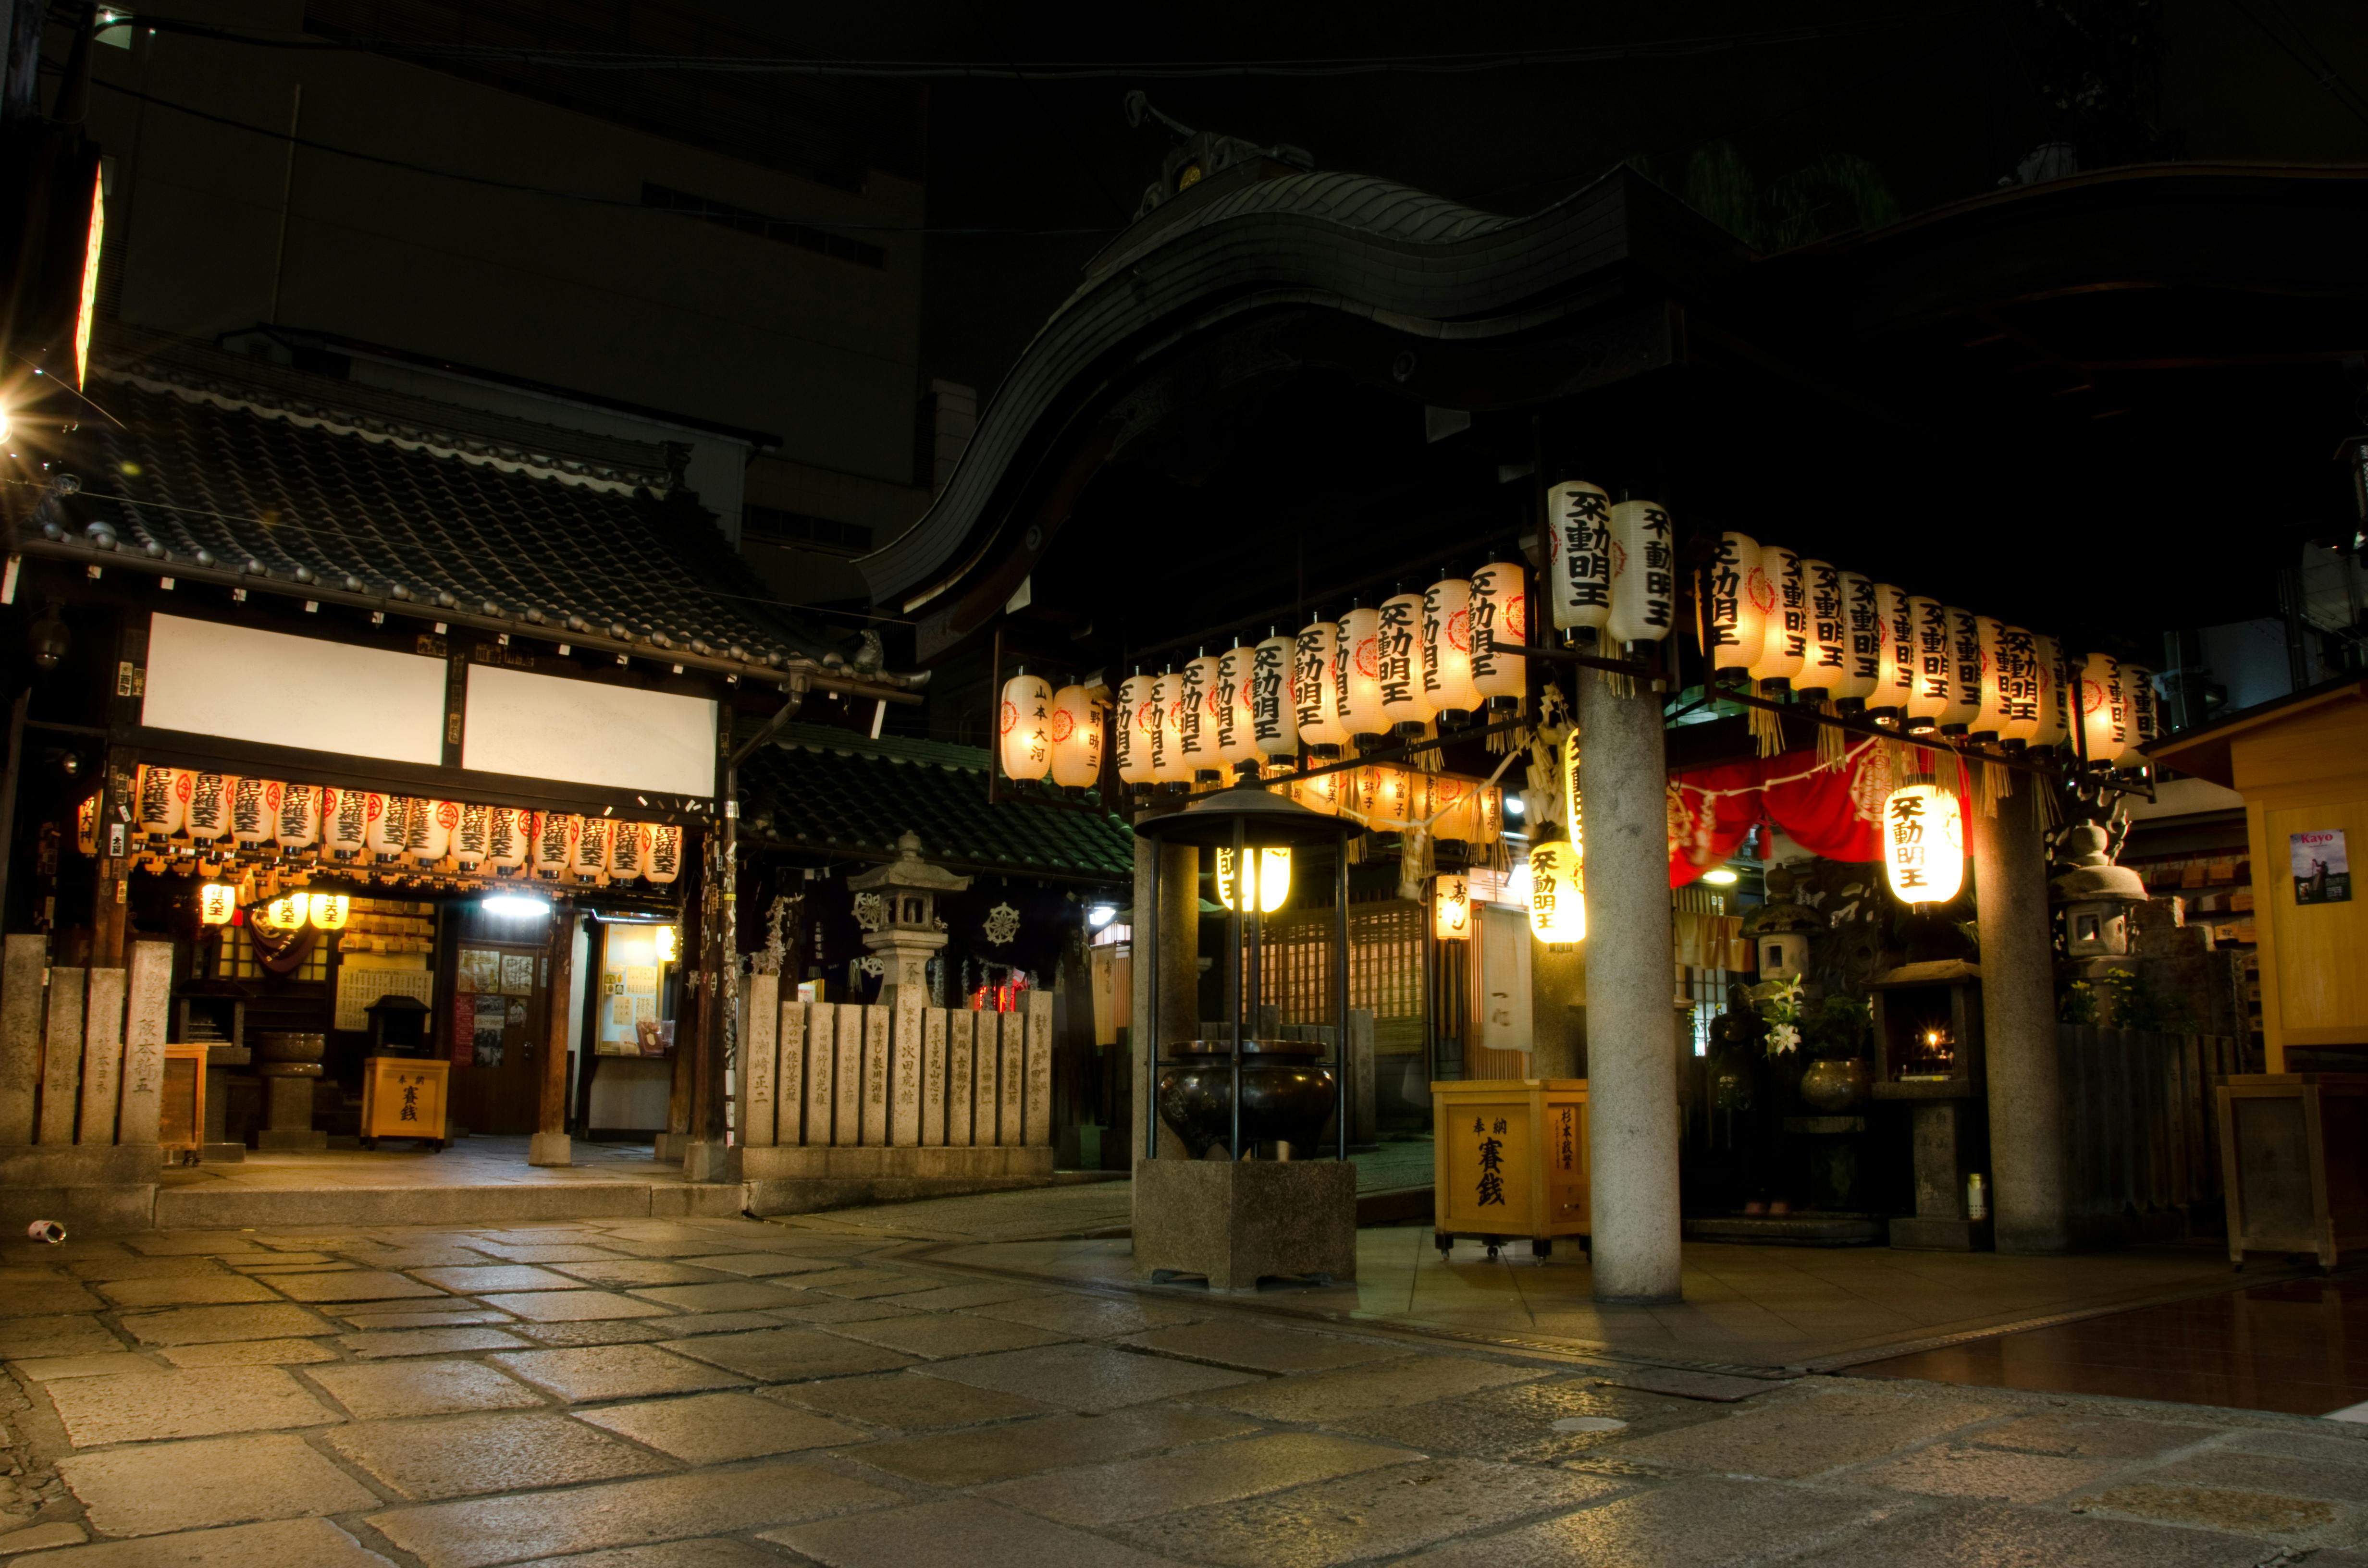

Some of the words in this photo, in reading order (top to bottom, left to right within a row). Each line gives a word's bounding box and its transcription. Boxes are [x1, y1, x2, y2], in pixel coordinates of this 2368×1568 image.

[1565, 491, 1611, 609] 不動明王
[1642, 508, 1671, 627] 不動明王
[1377, 602, 1414, 706] 不動明王
[1468, 571, 1497, 679] 不動明王
[1252, 646, 1283, 742] 不動明王
[1295, 629, 1325, 729] 不動明王
[2007, 630, 2037, 722] 不動明王
[1031, 685, 1048, 762] 山本大河
[1891, 796, 1928, 888] 不動明王
[2301, 834, 2333, 845] Kayo
[1450, 880, 1467, 930] 寿し
[1532, 851, 1559, 928] 不動明王
[400, 1086, 419, 1122] 賽銭
[1473, 1117, 1507, 1137] 奉納
[1475, 1137, 1505, 1207] 賽銭
